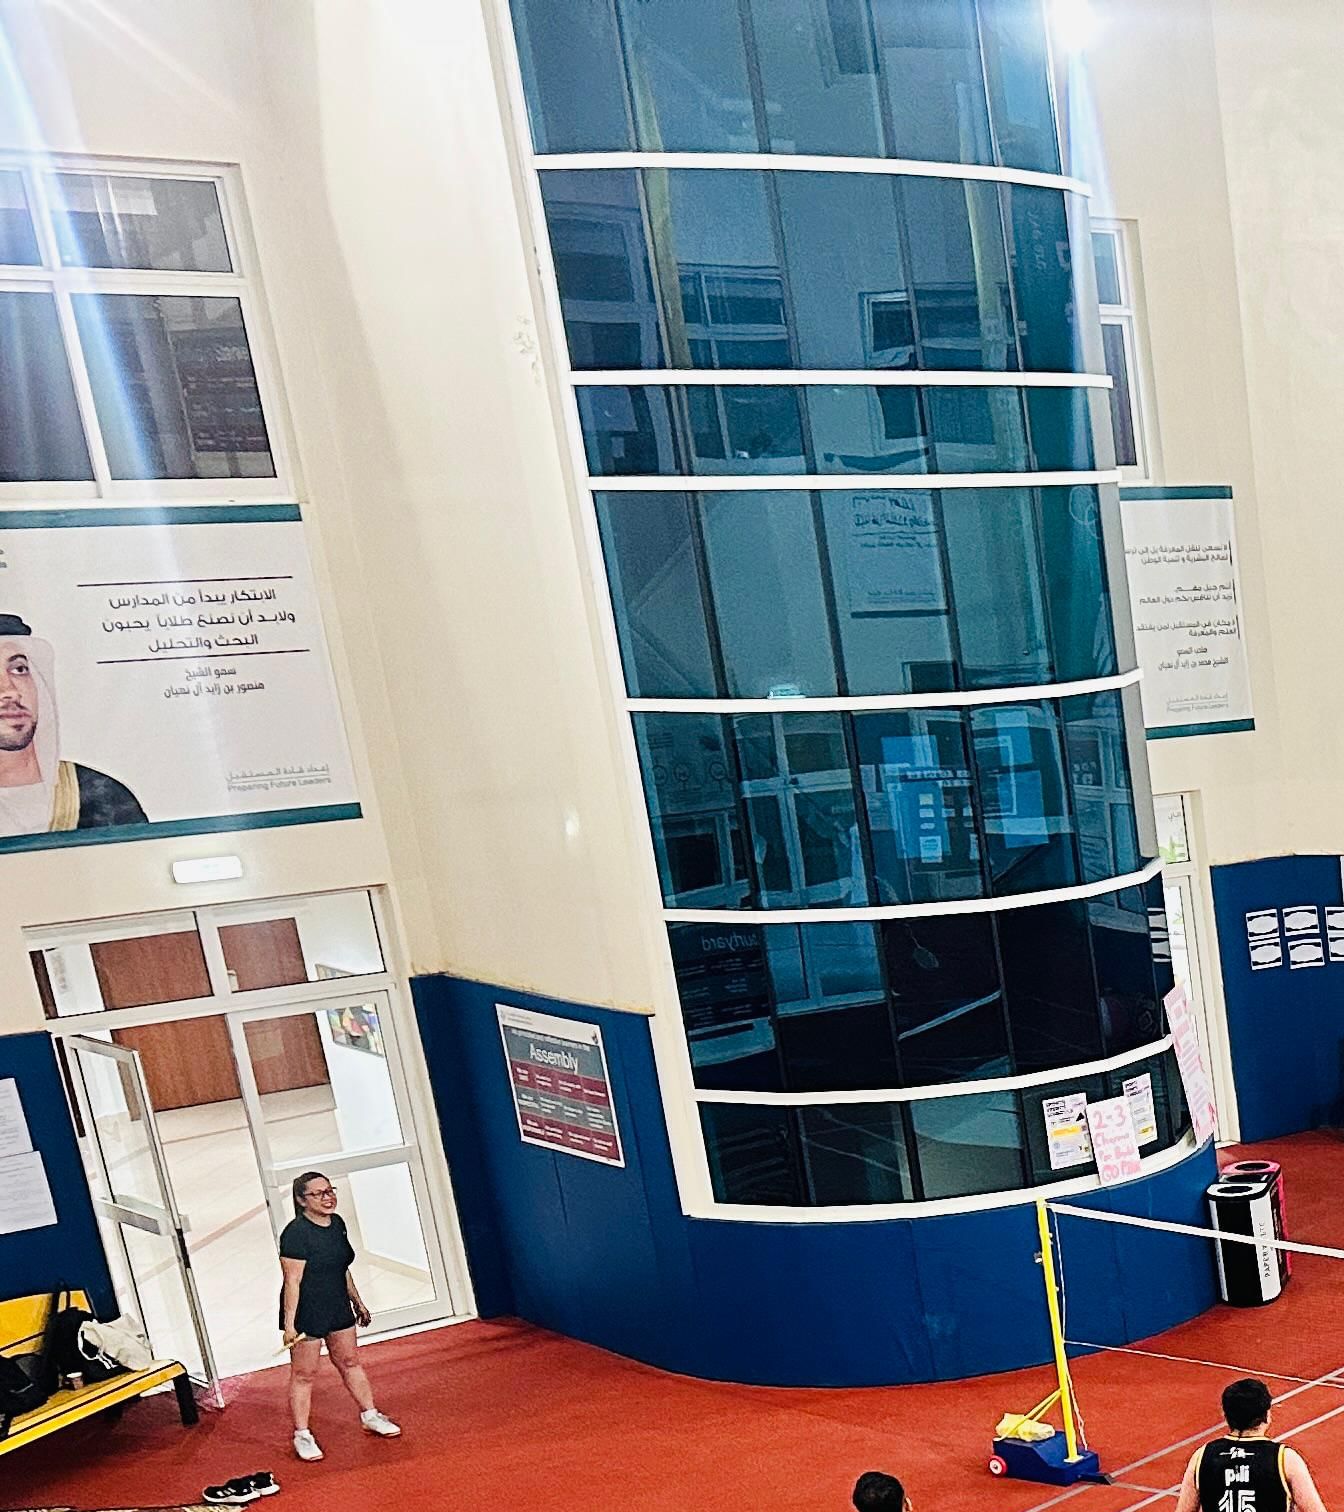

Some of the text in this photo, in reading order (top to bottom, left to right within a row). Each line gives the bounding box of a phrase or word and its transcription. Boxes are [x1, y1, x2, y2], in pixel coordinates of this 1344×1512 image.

[109, 593, 169, 609] المدارس
[173, 593, 196, 606] من
[529, 1043, 579, 1075] Assembly
